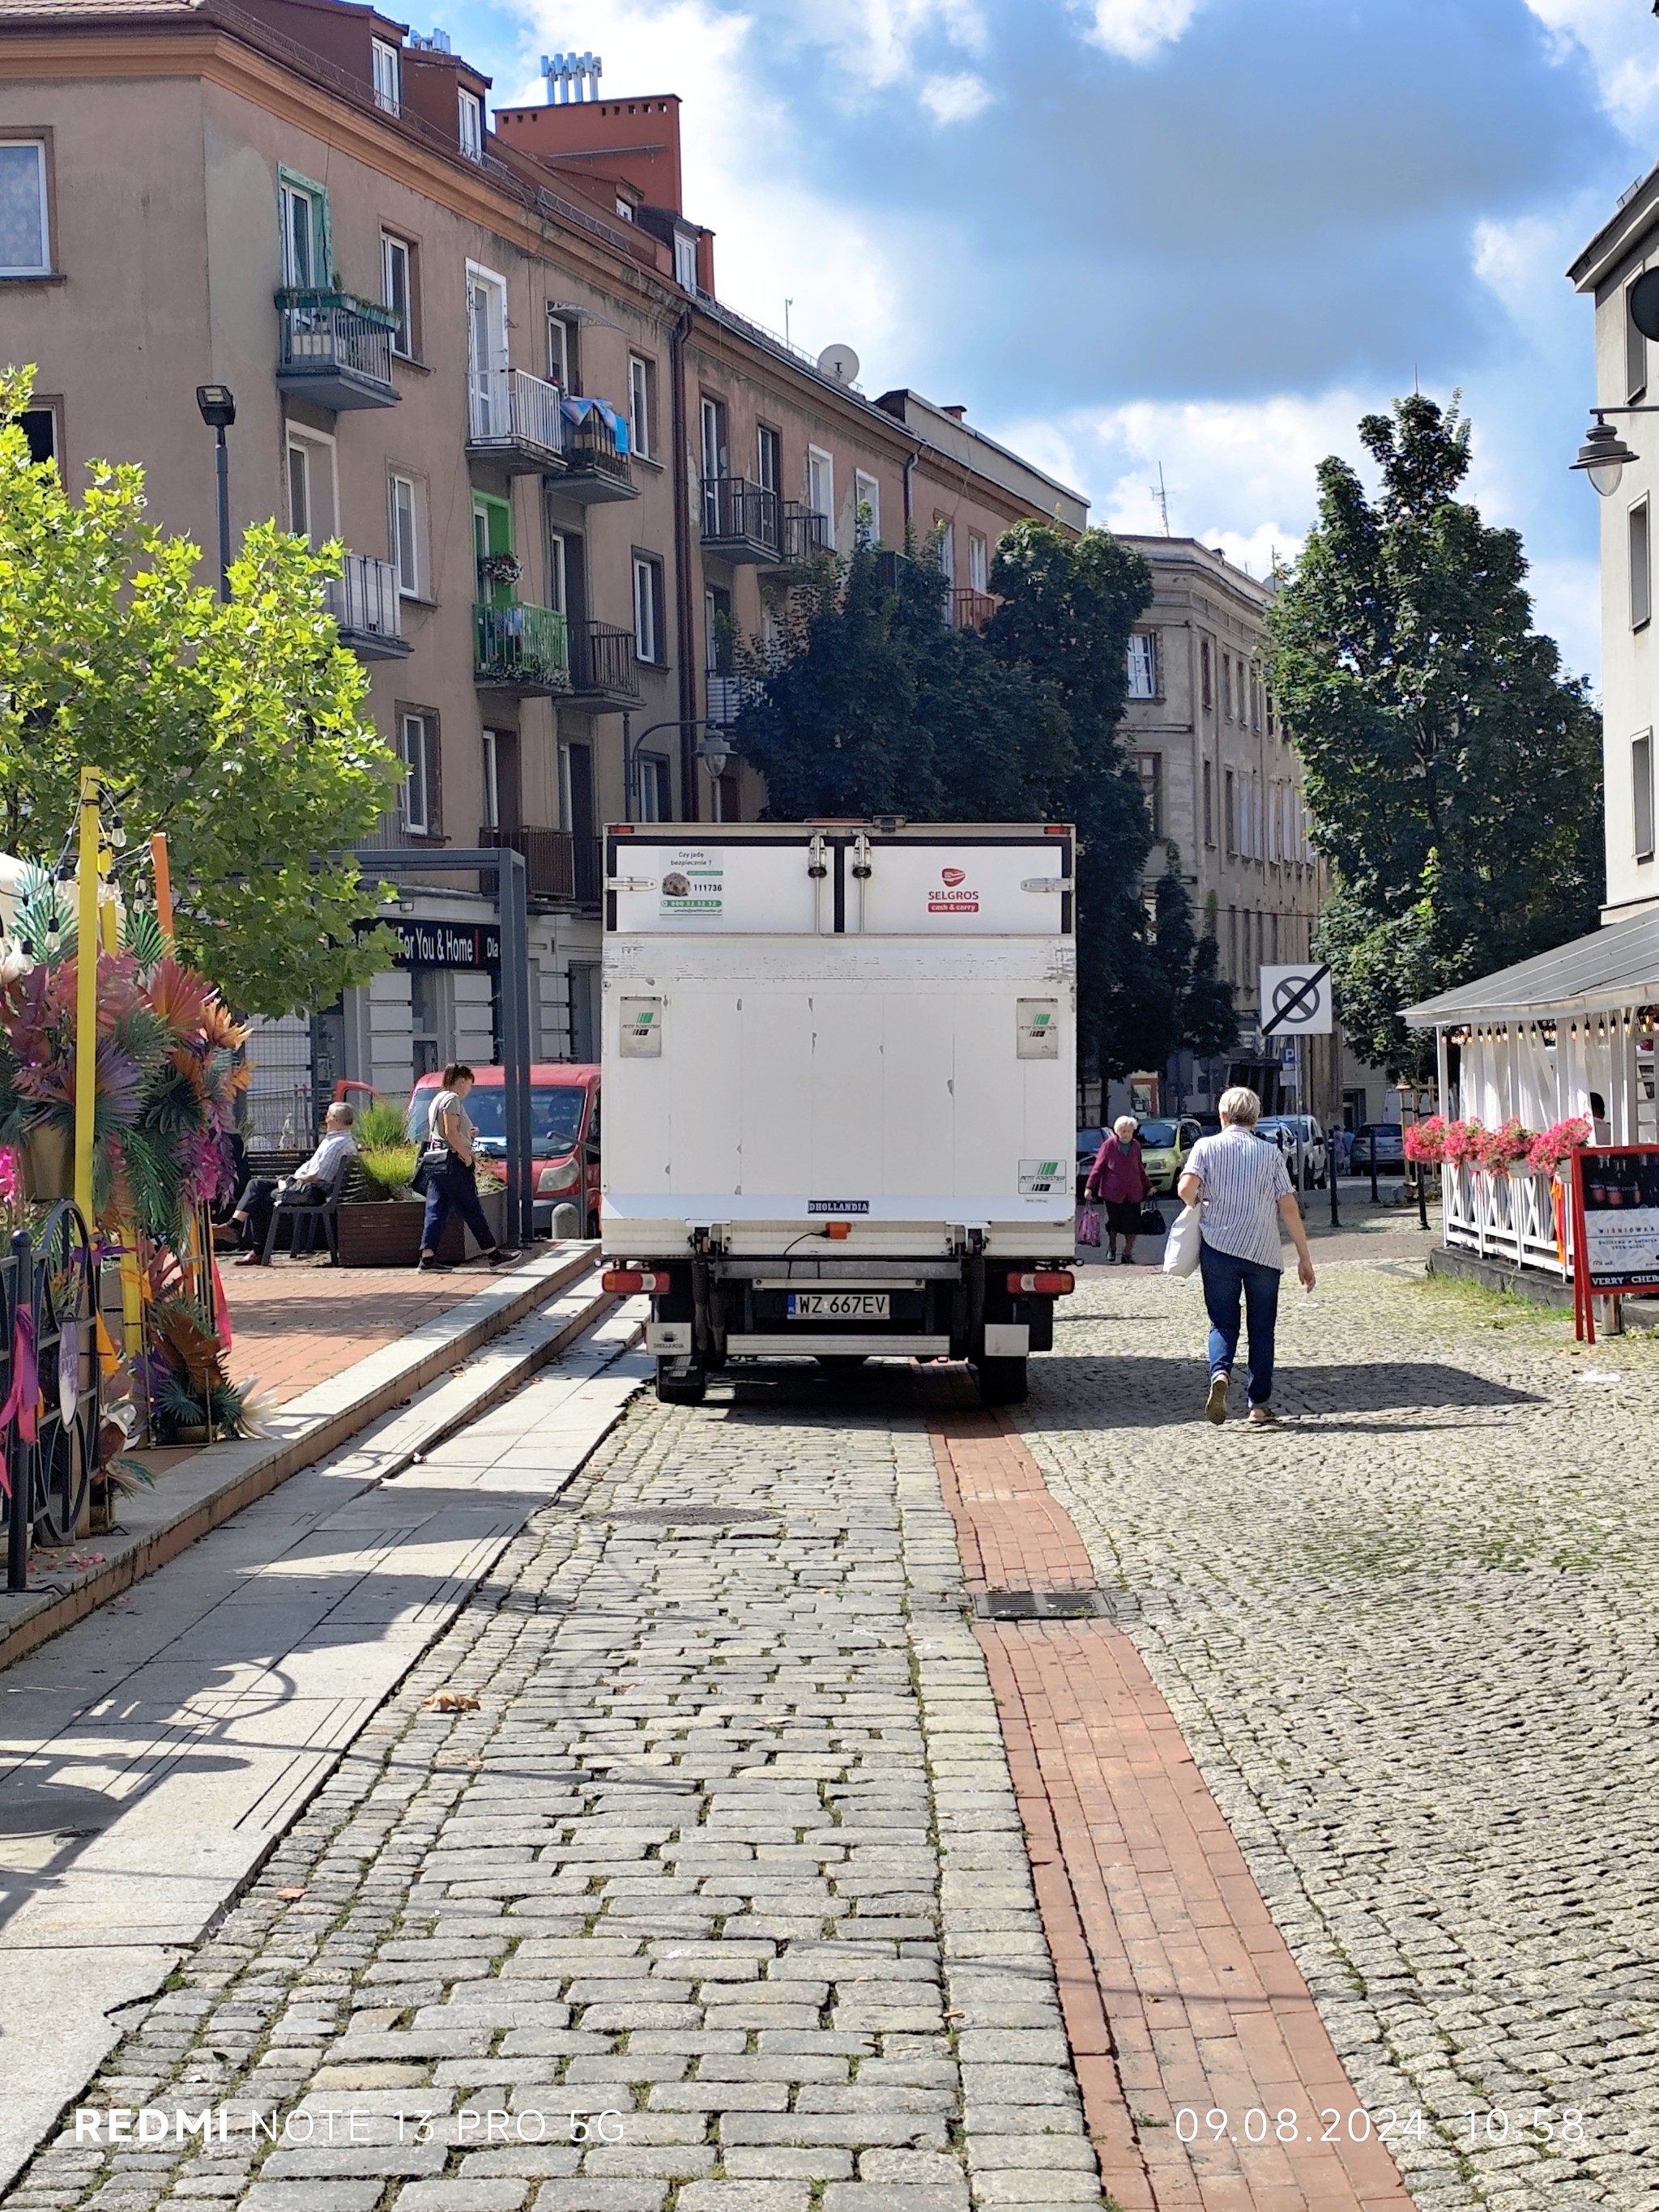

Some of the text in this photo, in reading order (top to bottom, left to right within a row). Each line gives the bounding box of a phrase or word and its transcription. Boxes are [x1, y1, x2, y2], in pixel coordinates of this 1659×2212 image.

[928, 890, 979, 900] SELGROS
[956, 904, 975, 912] carry
[397, 927, 414, 959] For
[416, 927, 434, 961] You
[437, 929, 445, 961] &
[446, 931, 473, 962] Home
[487, 937, 498, 958] Dla
[809, 1202, 868, 1212] DHOLLANDIA
[1592, 1276, 1624, 1285] VERRY
[799, 1296, 886, 1313] WZ 667EV
